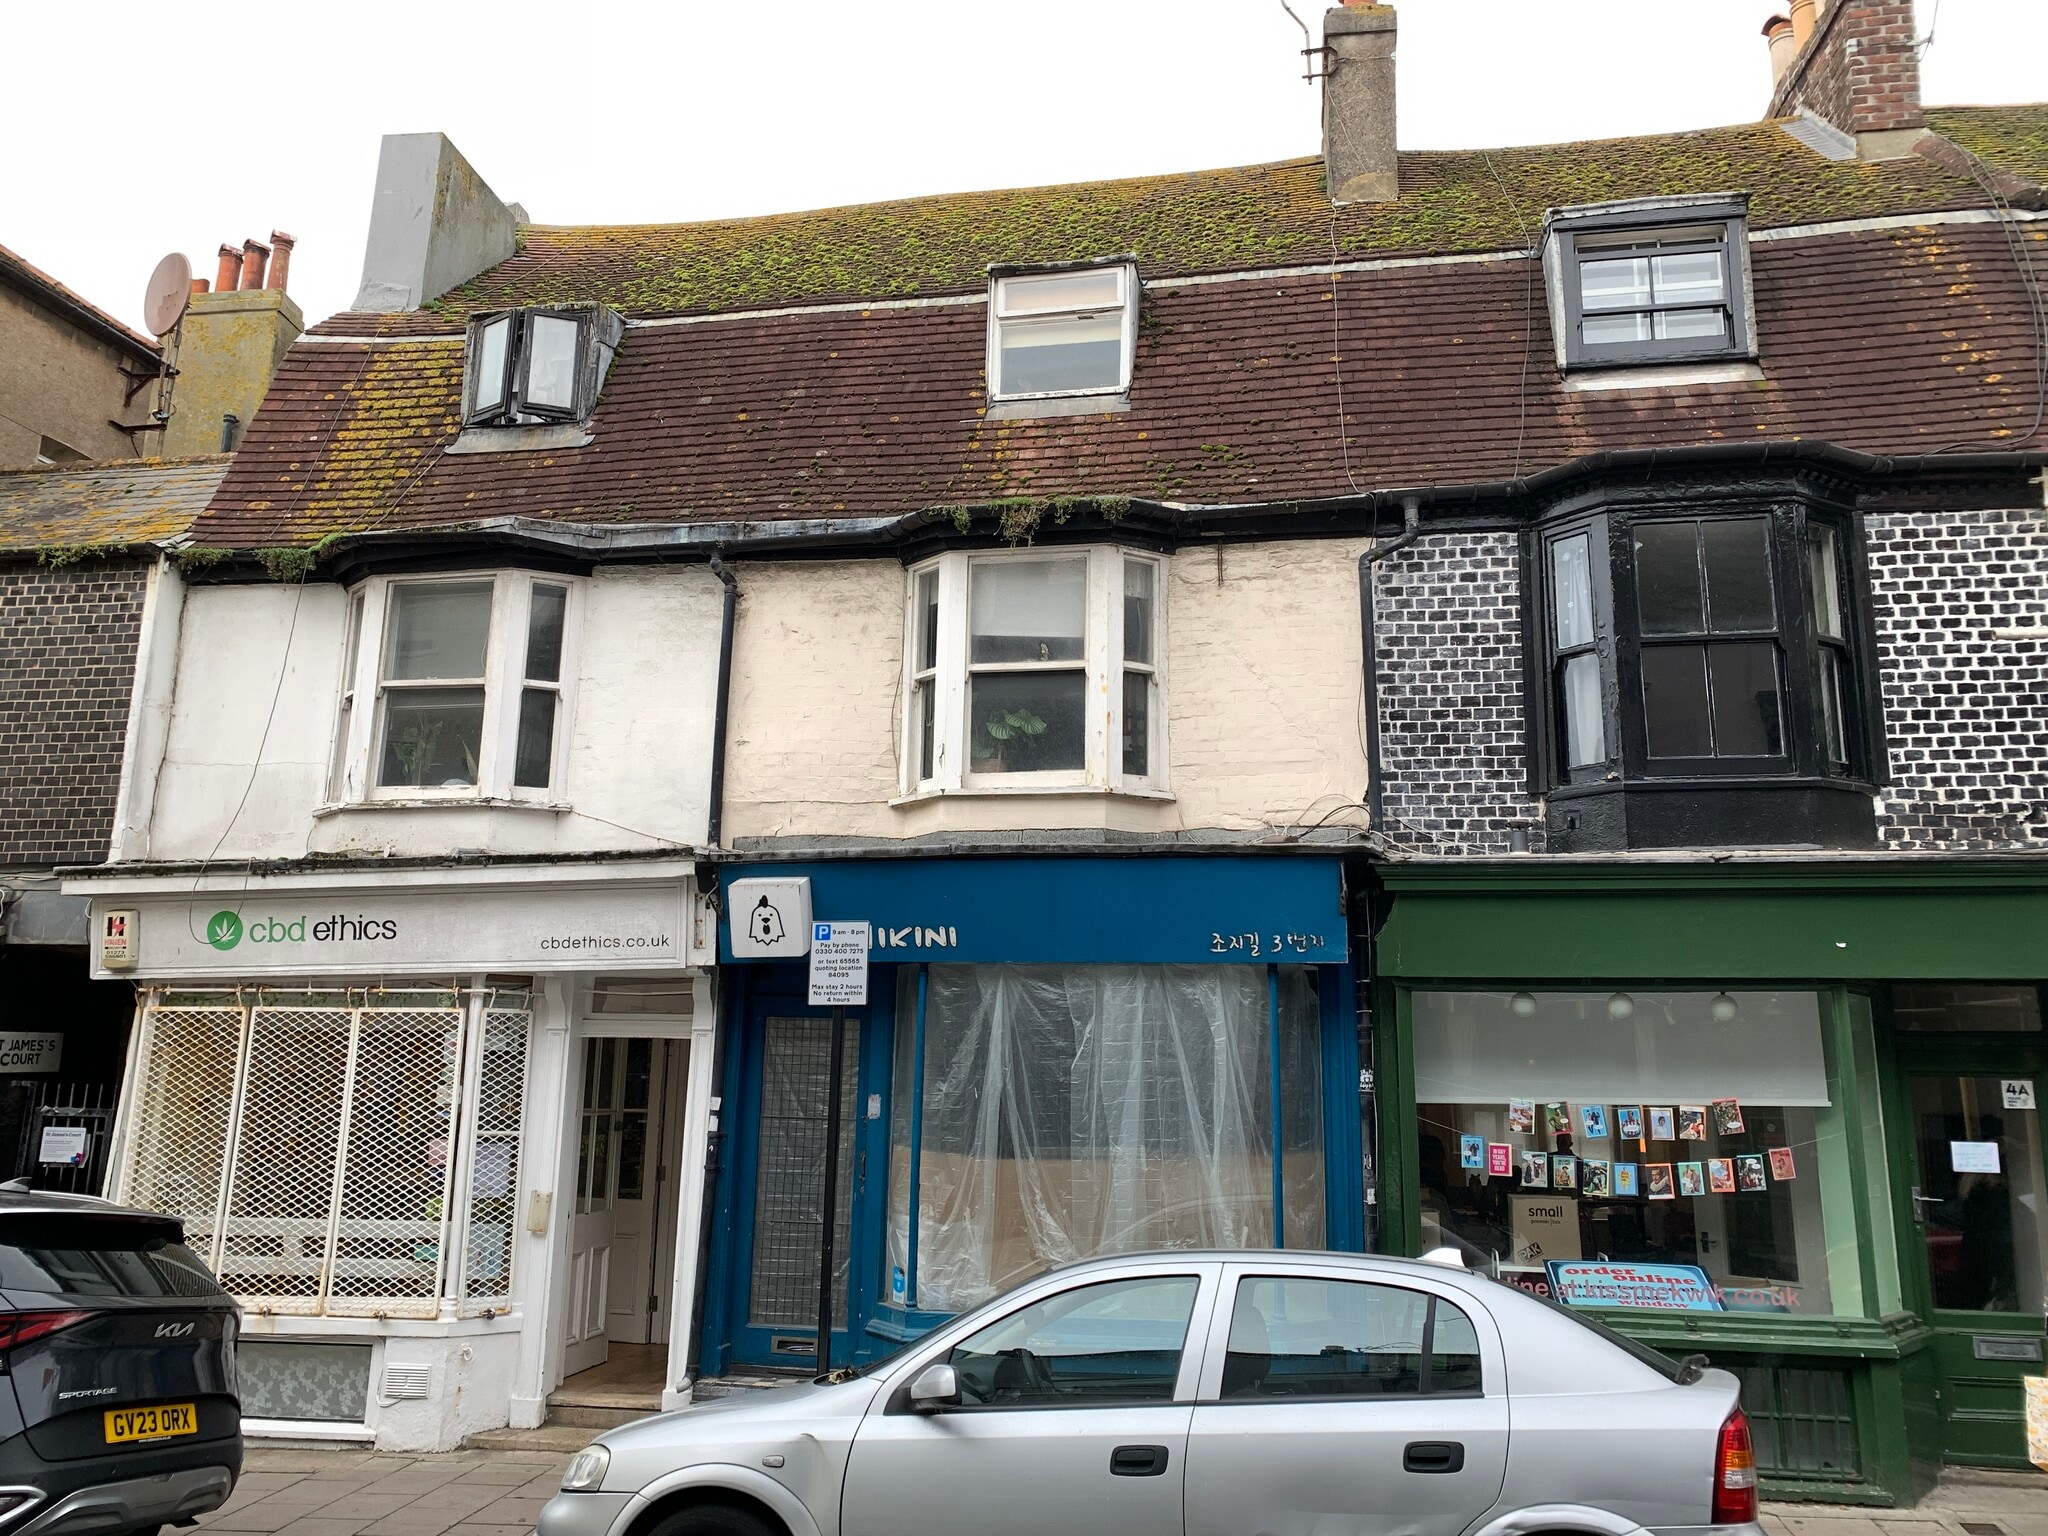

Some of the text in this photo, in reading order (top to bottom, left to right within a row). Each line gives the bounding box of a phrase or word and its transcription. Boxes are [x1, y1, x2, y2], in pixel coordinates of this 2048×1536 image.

[250, 914, 397, 943] cbd ethics
[818, 926, 829, 939] P
[105, 938, 127, 946] HAVEN
[540, 934, 670, 949] cbdethics.co.uk
[9, 1039, 56, 1051] JAMES'S
[0, 1053, 41, 1066] COURT
[2006, 1083, 2030, 1096] 4A
[1528, 1205, 1563, 1218] small
[1520, 1243, 1542, 1261] PAK
[1564, 1266, 1636, 1275] order
[1612, 1274, 1697, 1286] online
[1556, 1279, 1579, 1299] at
[1585, 1279, 1800, 1307] kissmekwik.co.uk
[1617, 1299, 1690, 1309] window
[154, 1322, 196, 1338] KIA
[58, 1387, 118, 1400] SPORTAGE
[113, 1407, 191, 1438] GV23 ORX
